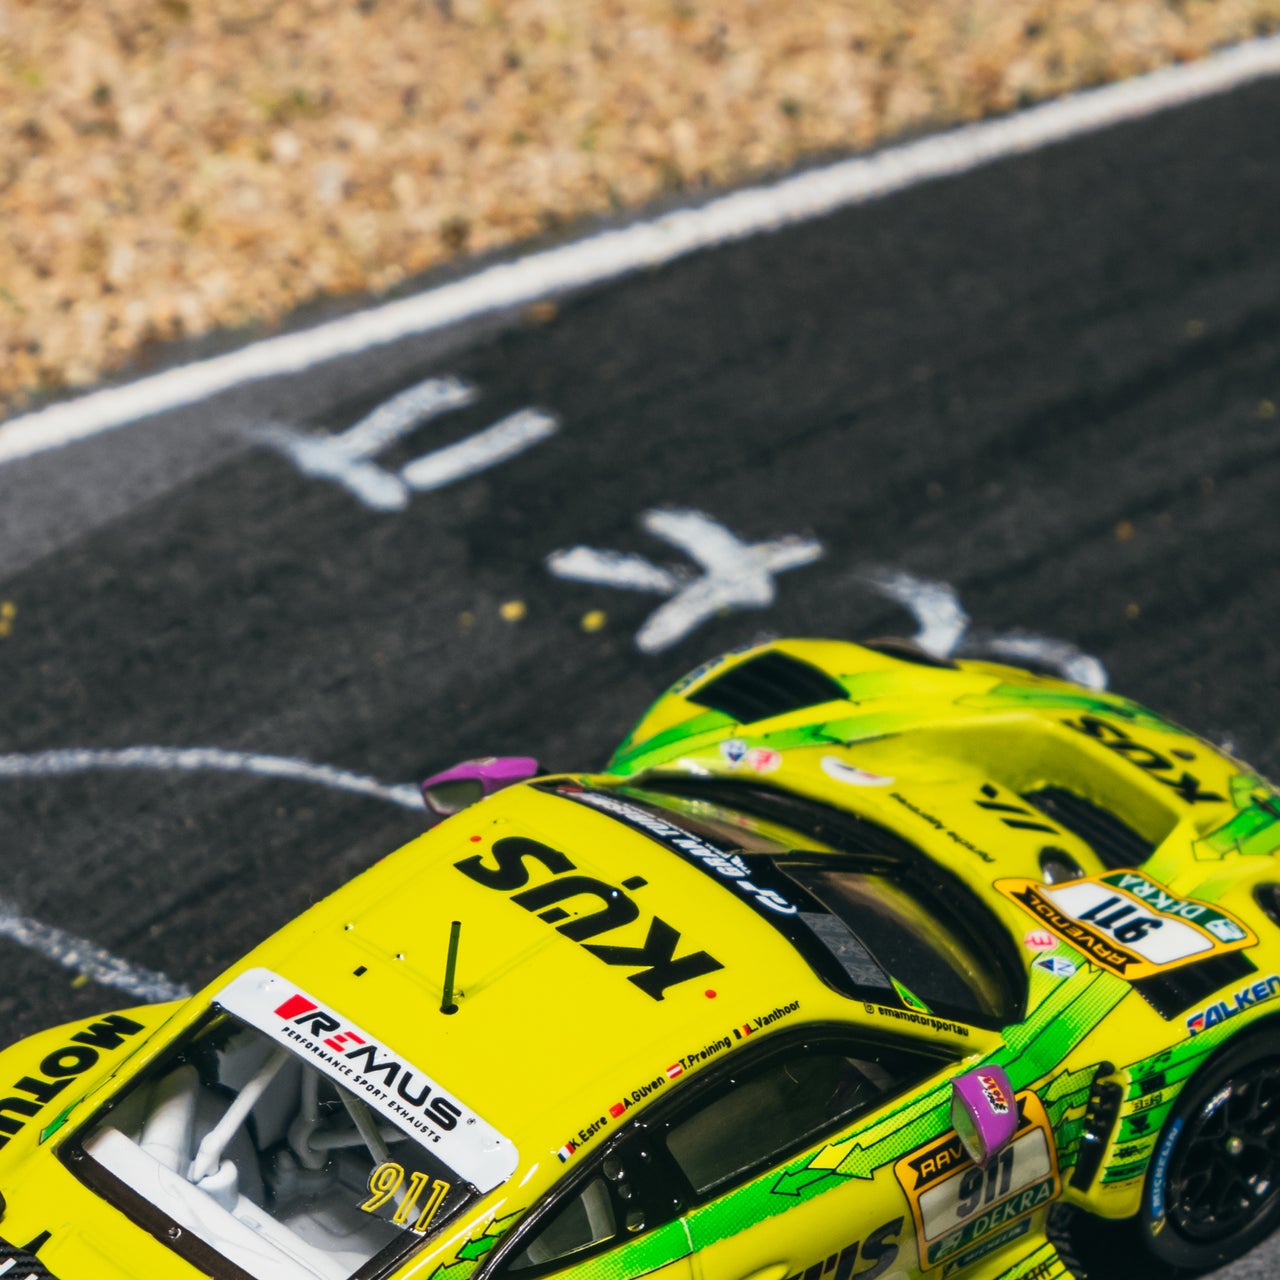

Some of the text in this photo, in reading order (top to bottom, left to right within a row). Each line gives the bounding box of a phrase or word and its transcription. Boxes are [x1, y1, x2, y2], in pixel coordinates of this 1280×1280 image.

[1078, 896, 1163, 943] 911
[1118, 874, 1208, 919] DEKRA
[1030, 892, 1128, 966] RAVENOL
[747, 1000, 800, 1033] L.Vanthoor
[281, 1026, 442, 1144] PERFORMANCE SPORT EXHAUSTS
[292, 1010, 463, 1132] REMUS
[568, 1115, 608, 1150] K.Estre
[360, 1162, 451, 1232] 911
[956, 1146, 1015, 1218] 911
[972, 1181, 1051, 1239] DEKRA
